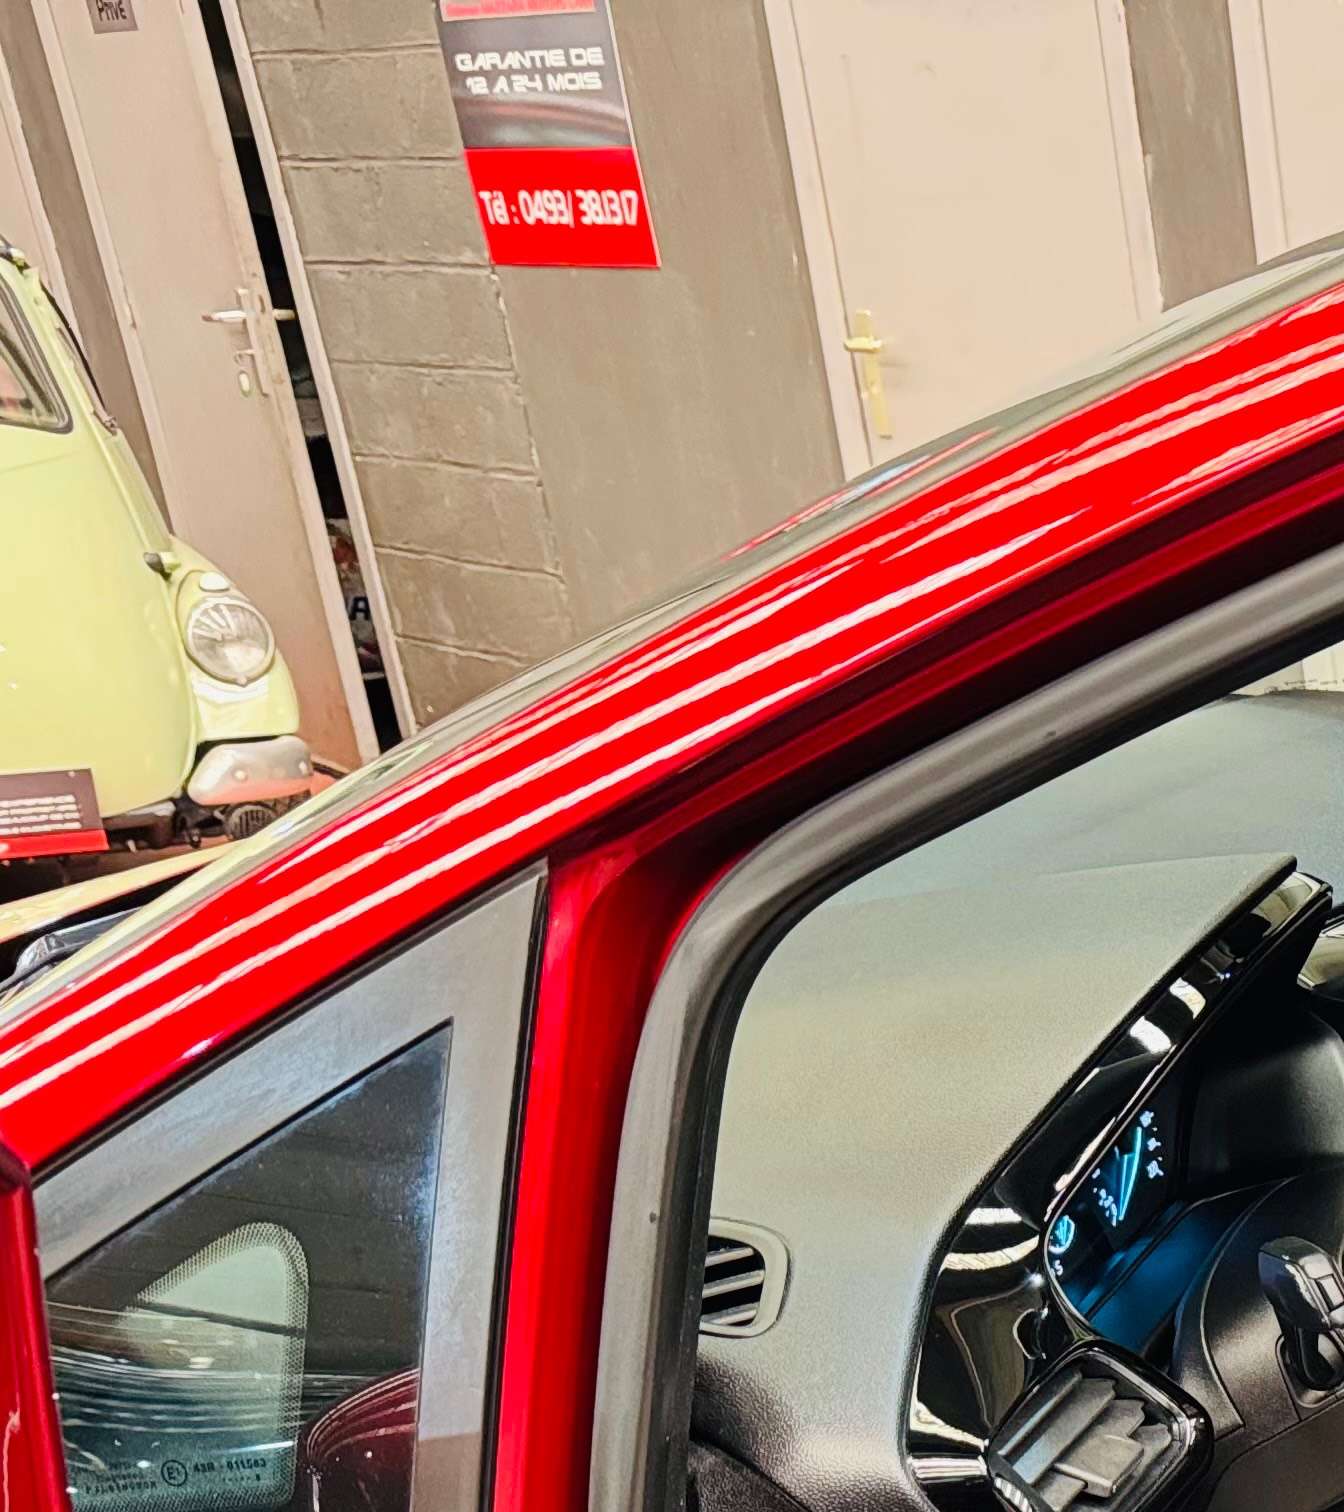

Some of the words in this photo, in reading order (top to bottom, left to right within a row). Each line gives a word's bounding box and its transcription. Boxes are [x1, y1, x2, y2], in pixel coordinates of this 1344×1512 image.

[455, 49, 567, 72] GARANTIE
[569, 47, 605, 66] DE
[466, 76, 489, 95] 12
[493, 75, 510, 94] A
[510, 74, 543, 93] 24
[546, 72, 602, 91] MOIS
